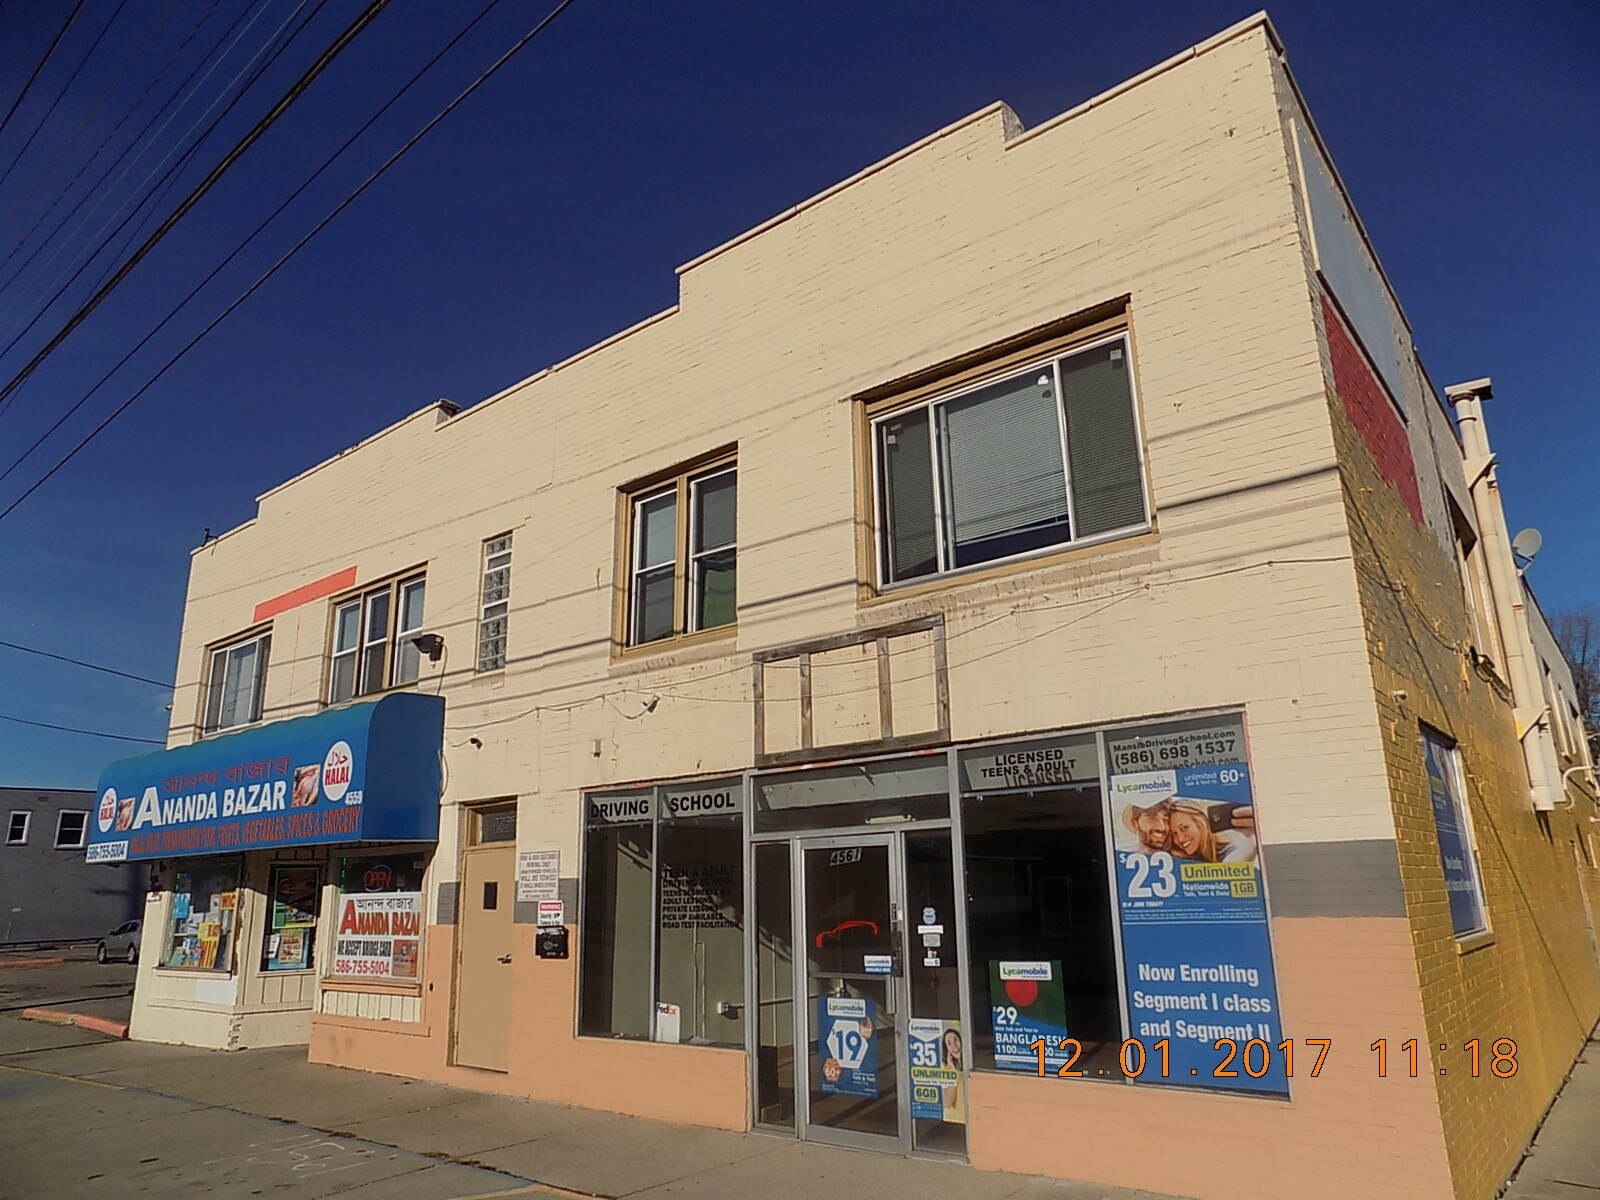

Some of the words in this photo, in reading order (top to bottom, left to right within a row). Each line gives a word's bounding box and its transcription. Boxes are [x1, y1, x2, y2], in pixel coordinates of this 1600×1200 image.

[1113, 730, 1236, 752] MansibDrivingSchool.com
[995, 750, 1063, 767] LICENSED
[1115, 748, 1154, 768] (586)
[1159, 745, 1189, 760] 698
[1195, 740, 1236, 756] 1537
[325, 766, 349, 786] HALAL
[981, 765, 1019, 778] TEENS
[1024, 764, 1032, 776] &
[1037, 759, 1076, 773] ADULT
[1220, 769, 1245, 783] 60+
[1117, 780, 1171, 793] Lycamobile
[131, 786, 217, 830] ANANDA
[222, 780, 287, 817] BAZAR
[591, 800, 649, 818] DRIVING
[671, 793, 735, 813] SCHOOL
[288, 811, 314, 839] SPICES
[322, 805, 361, 835] GROCERY
[364, 870, 391, 888] OPEN
[1185, 866, 1249, 880] Unlimited
[1183, 882, 1230, 891] Nationwide
[1232, 881, 1254, 894] 1GB
[338, 899, 389, 935] ANANDA
[335, 959, 390, 975] 586-755-5004
[1003, 967, 1048, 976] Lycamobile
[1139, 963, 1175, 982] Now
[1180, 964, 1259, 987] Enrolling
[1133, 991, 1208, 1013] Segment
[1211, 993, 1219, 1010] I
[1223, 994, 1272, 1013] class
[1140, 1019, 1171, 1038] and
[1175, 1020, 1253, 1043] Segment
[996, 1045, 1017, 1054] 1100
[912, 1069, 958, 1080] UNLIMITED
[916, 1089, 936, 1098] 6GB
